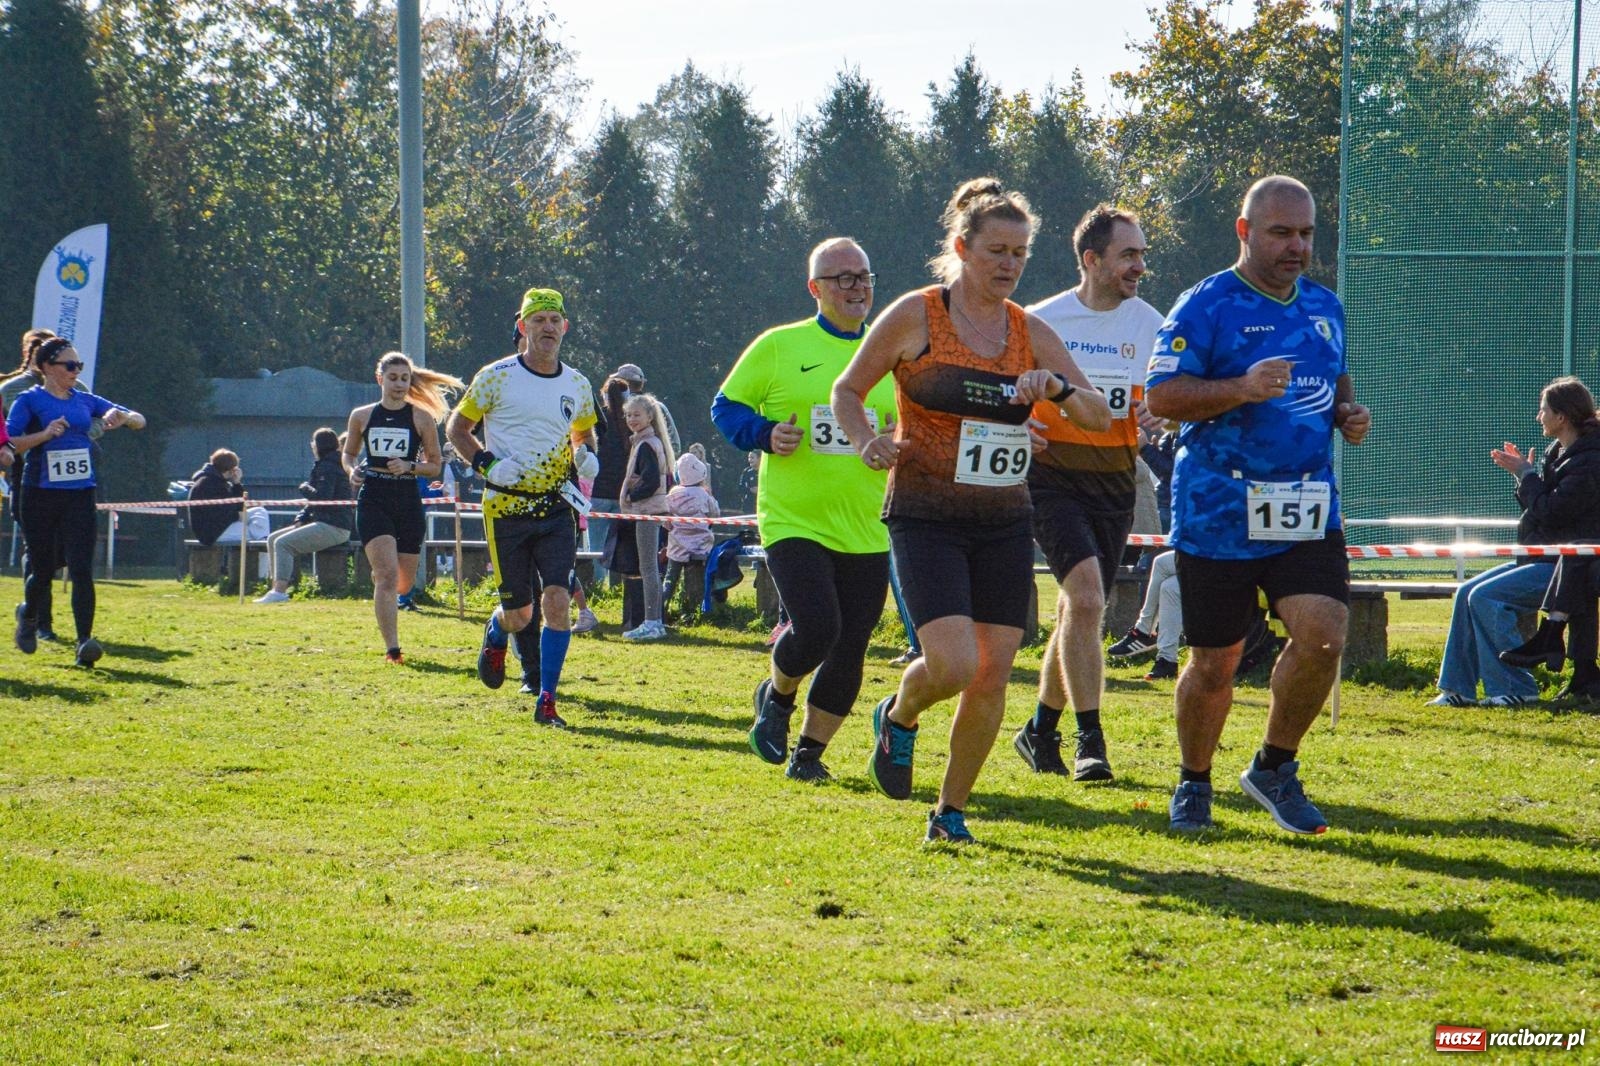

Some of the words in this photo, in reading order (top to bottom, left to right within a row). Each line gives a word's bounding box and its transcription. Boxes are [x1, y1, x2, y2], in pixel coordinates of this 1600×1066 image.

[1081, 343, 1118, 354] Hybris
[371, 438, 407, 452] 174
[965, 444, 1028, 475] 169
[52, 460, 89, 476] 185
[1255, 502, 1322, 530] 151
